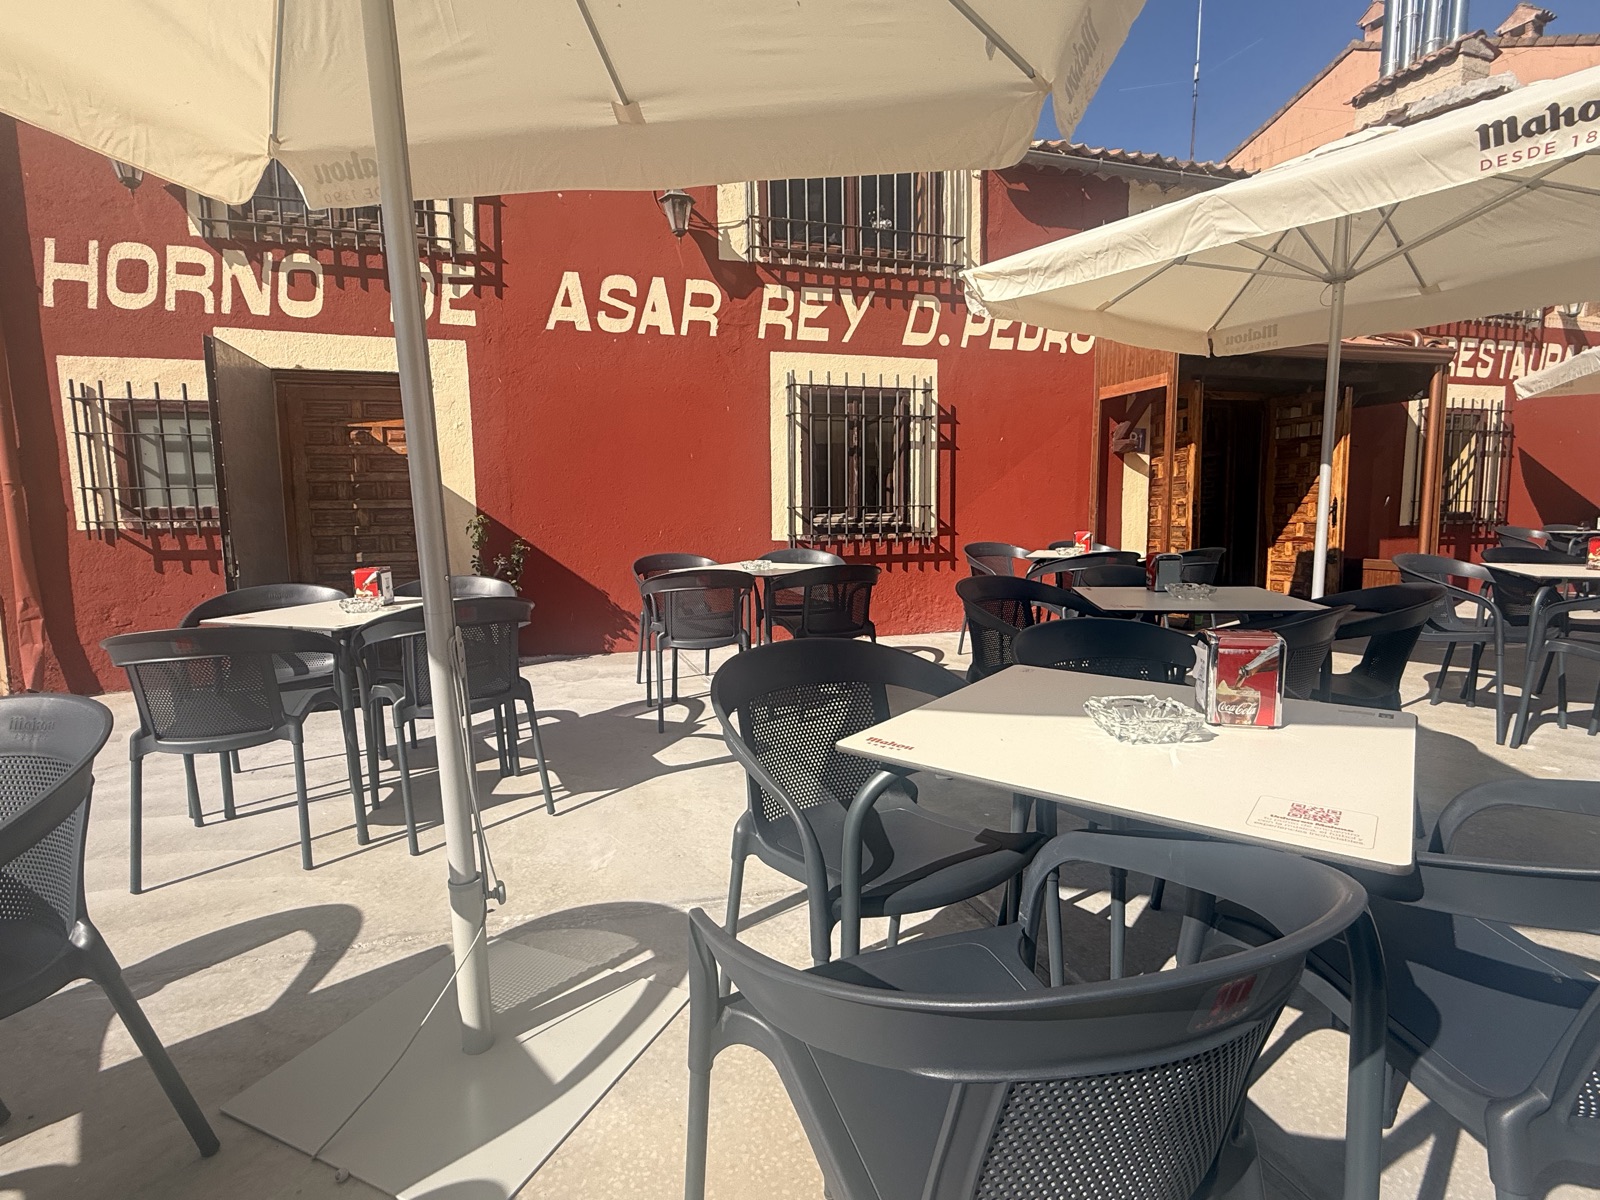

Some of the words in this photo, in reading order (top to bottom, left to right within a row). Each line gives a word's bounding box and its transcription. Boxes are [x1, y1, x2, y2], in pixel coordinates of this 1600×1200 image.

[1480, 141, 1556, 171] DESDE
[43, 237, 324, 318] HORNO
[545, 271, 722, 337] ASAR
[757, 284, 875, 343] REY
[902, 294, 950, 346] D.
